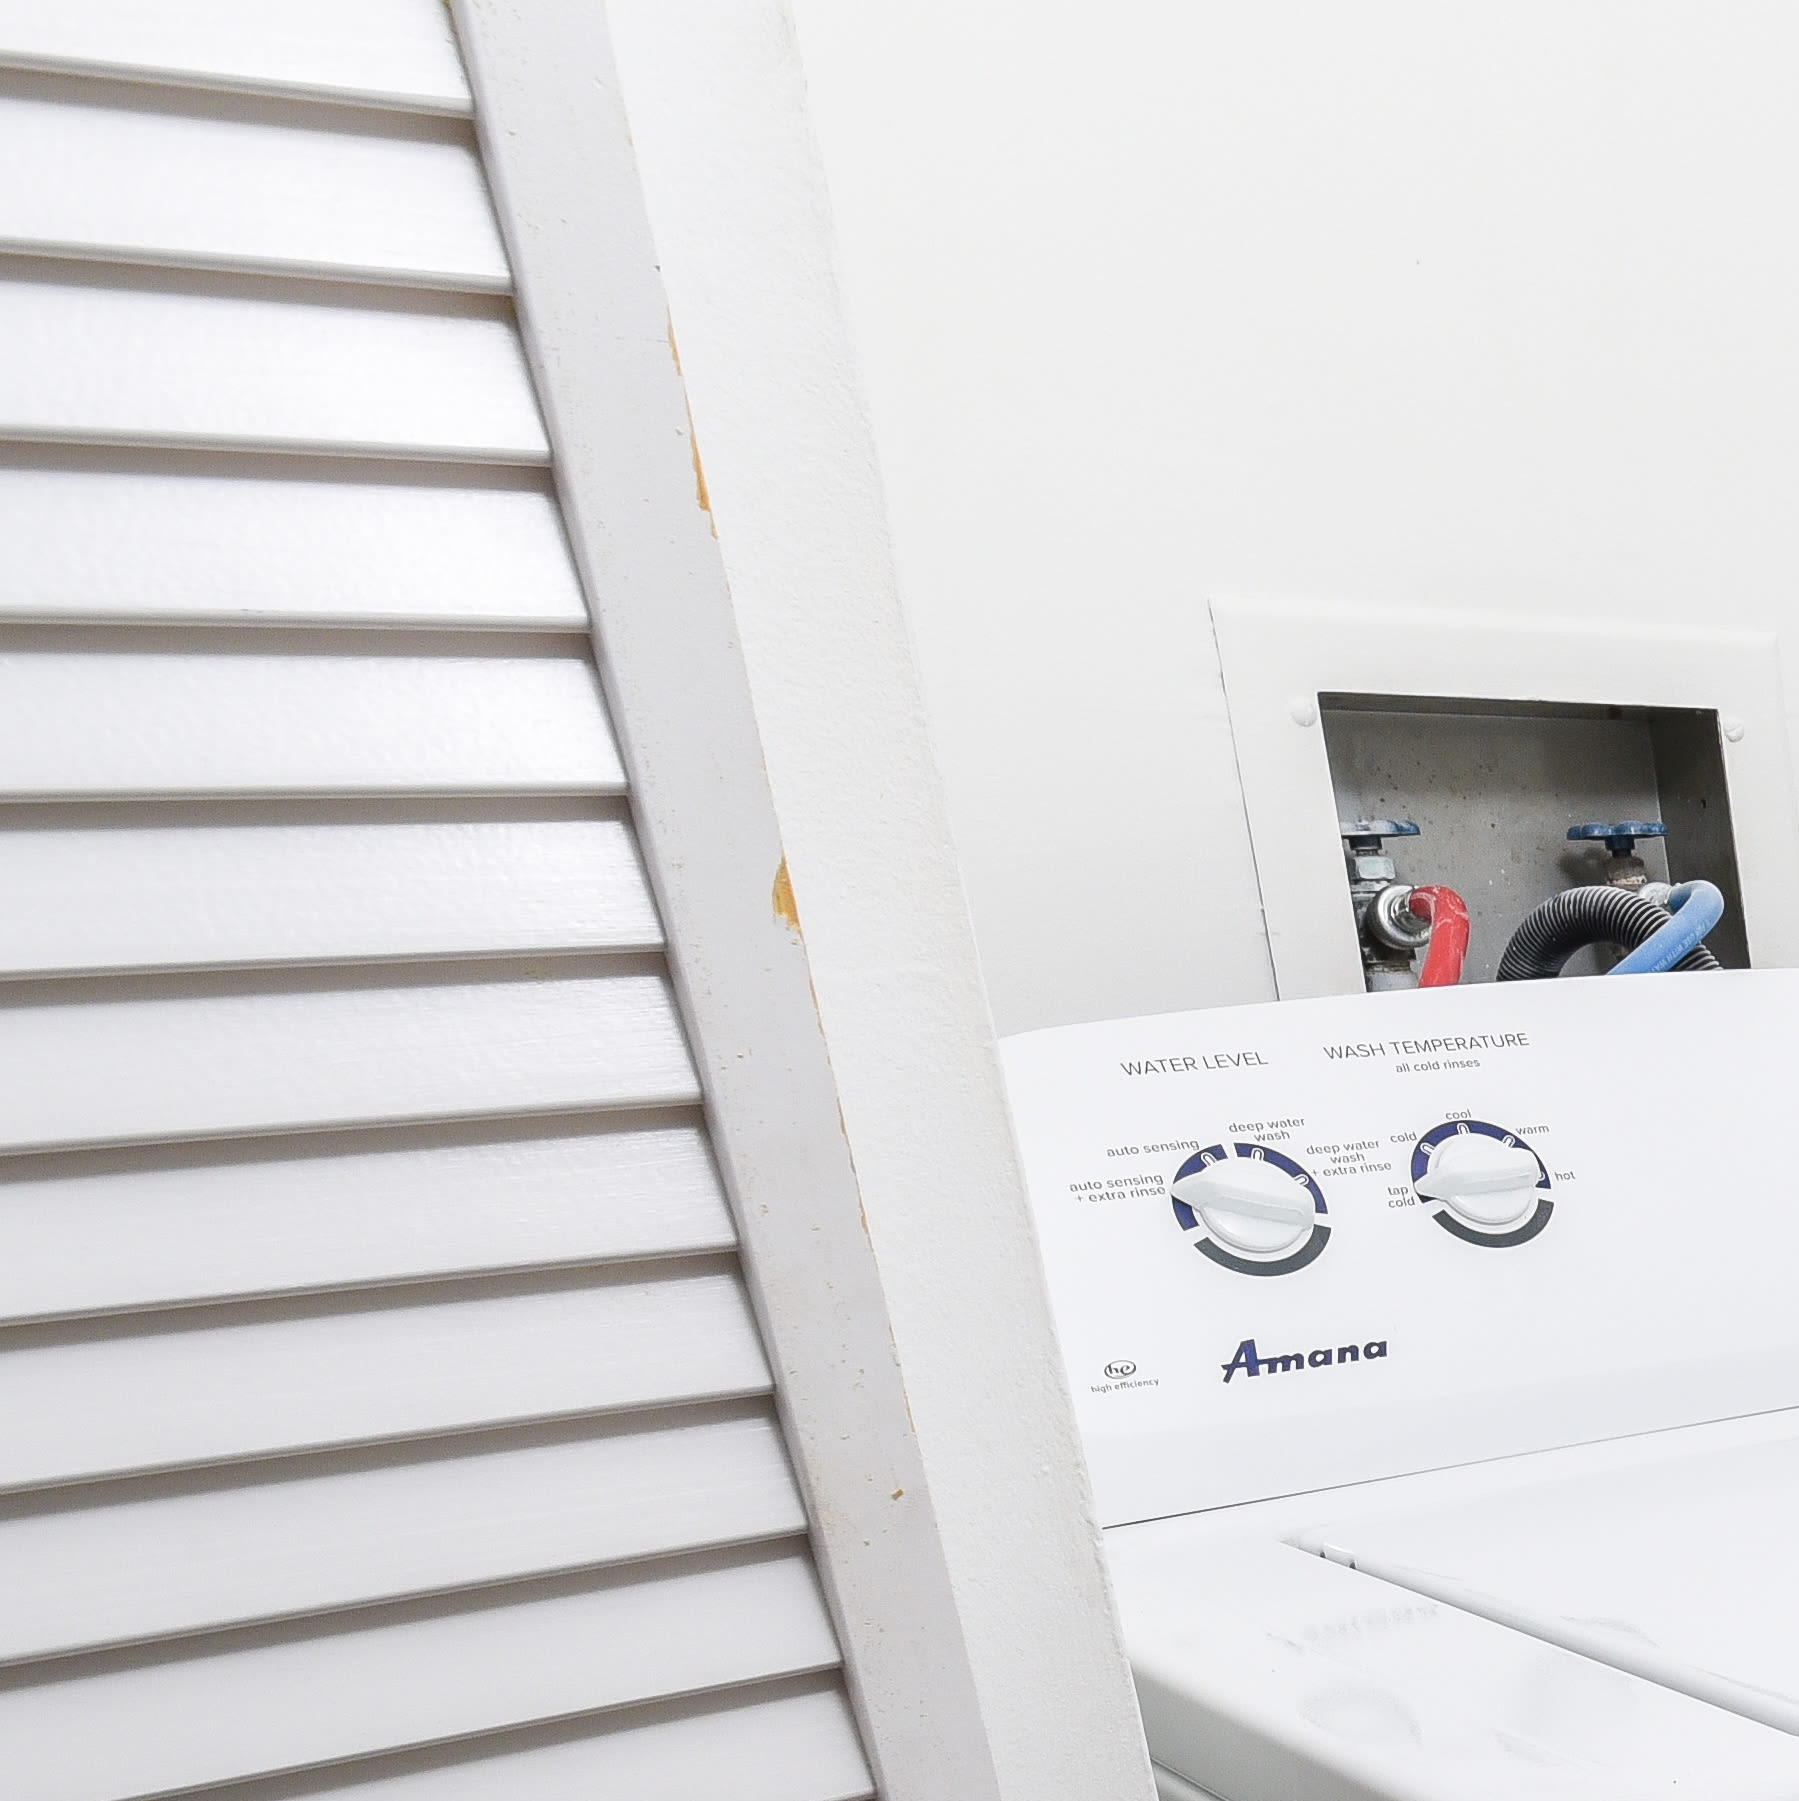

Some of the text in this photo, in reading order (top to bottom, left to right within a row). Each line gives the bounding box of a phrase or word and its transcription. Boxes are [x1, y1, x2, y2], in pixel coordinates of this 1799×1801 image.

[1323, 1033, 1529, 1060] WASH TEMPERATURE
[1119, 1052, 1268, 1076] WATER LEVEL
[1396, 1059, 1480, 1073] all cold rinses
[1445, 1109, 1472, 1120] cool
[1228, 1118, 1305, 1133] deep water
[1515, 1125, 1550, 1136] warm
[1254, 1130, 1290, 1142] wash
[1390, 1131, 1417, 1143] cold
[1107, 1139, 1200, 1156] auto sensing
[1306, 1140, 1380, 1156] deep water
[1329, 1153, 1366, 1164] wash
[1323, 1166, 1357, 1177] extra
[1360, 1162, 1392, 1173] rinse
[1554, 1171, 1576, 1181] hot
[1070, 1174, 1164, 1192] auto sensing
[1088, 1190, 1126, 1203] extra
[1130, 1186, 1166, 1198] rinse
[1387, 1186, 1409, 1199] tap
[1388, 1196, 1415, 1208] cold
[1221, 1339, 1389, 1384] Amana
[1090, 1378, 1159, 1393] high efficiency
